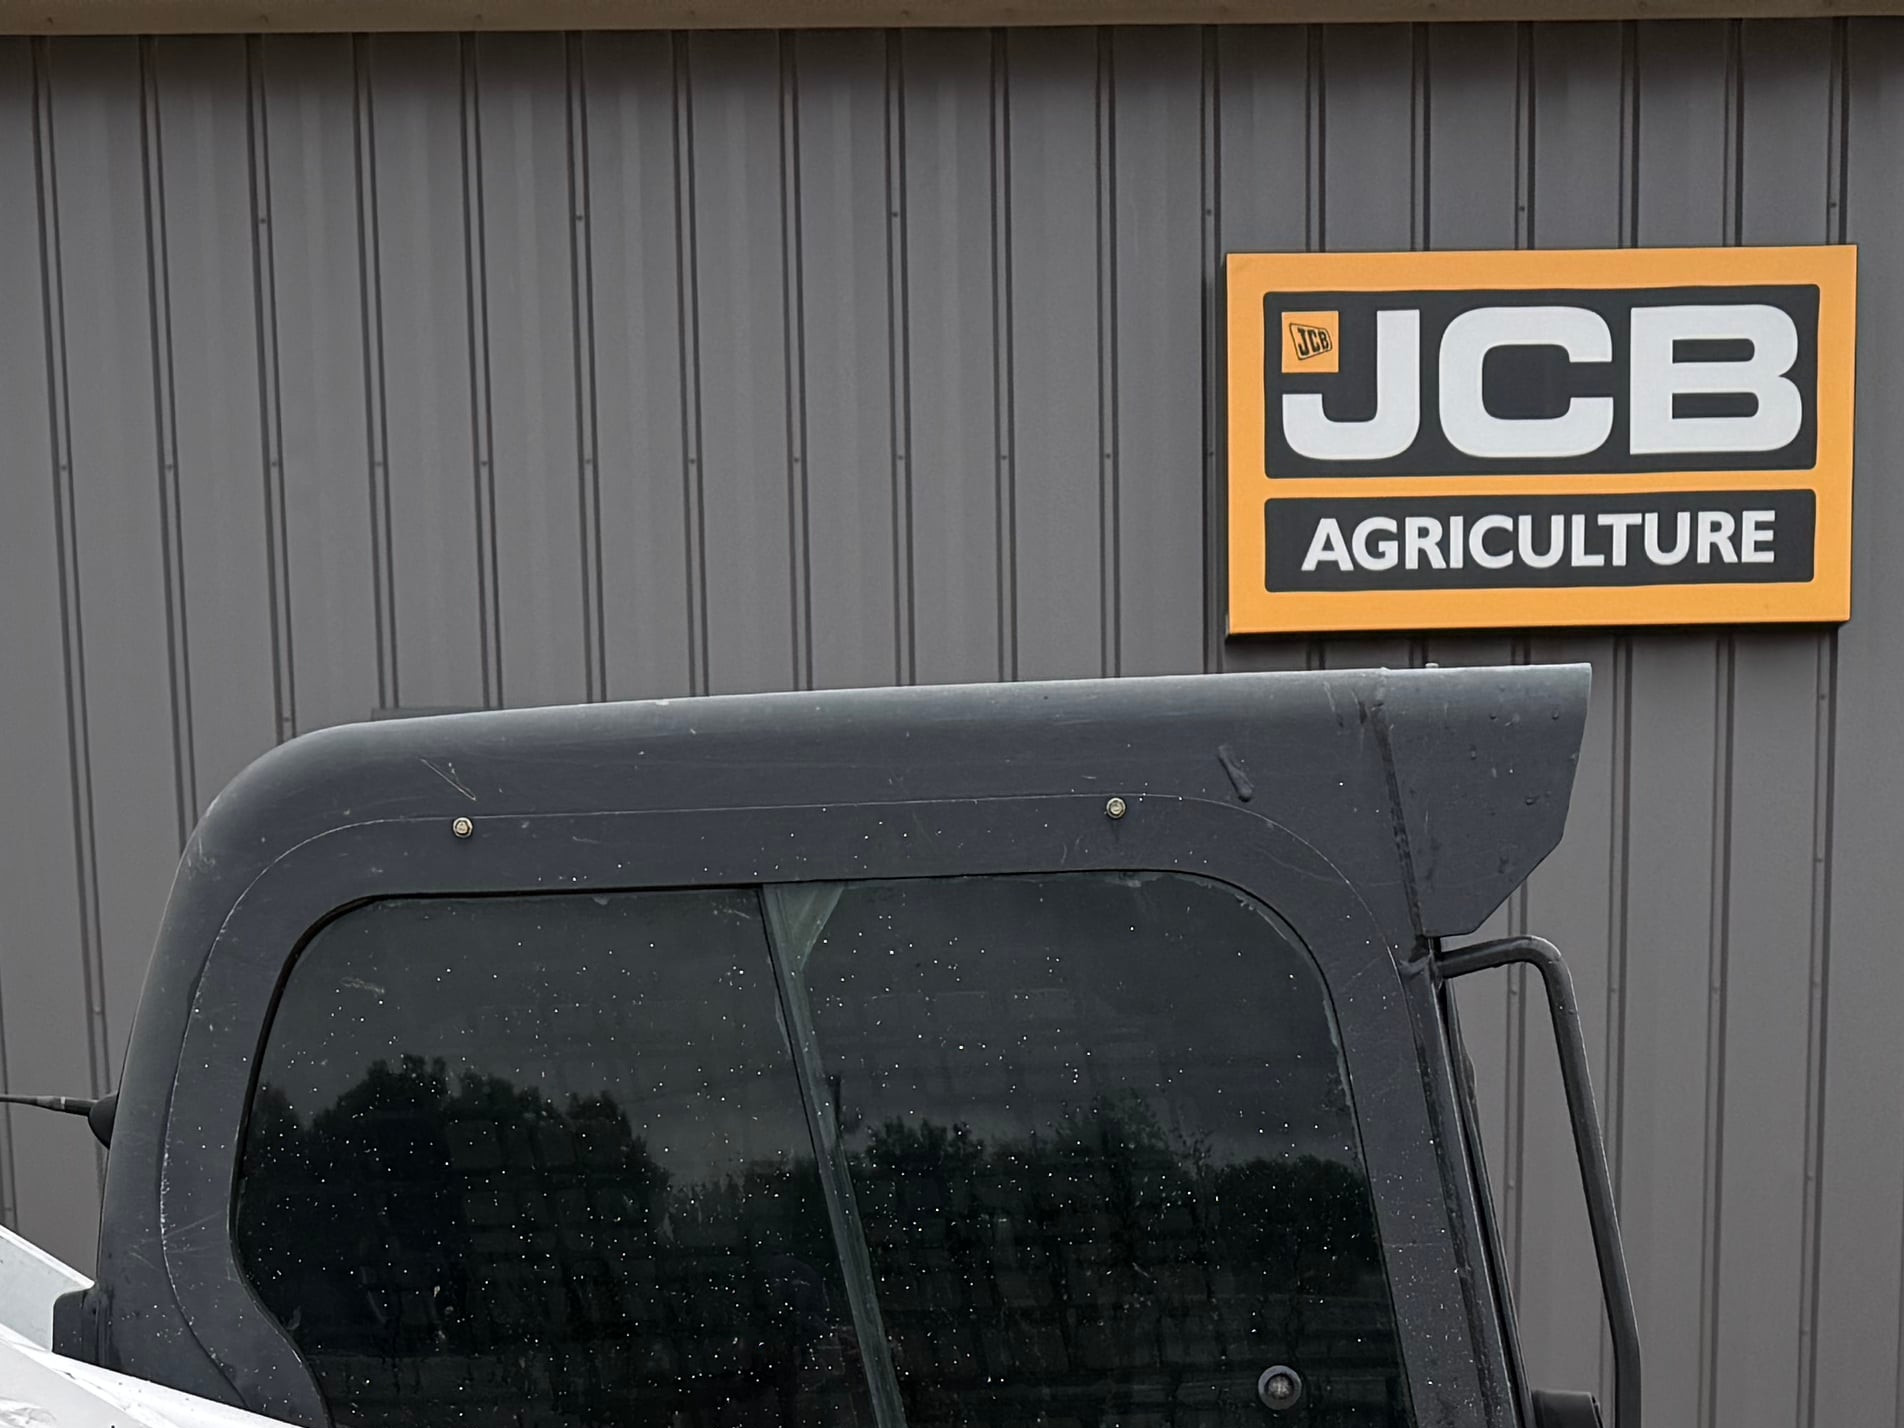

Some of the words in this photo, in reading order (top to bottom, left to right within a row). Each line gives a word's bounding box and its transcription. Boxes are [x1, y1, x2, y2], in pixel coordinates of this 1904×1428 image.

[1297, 326, 1330, 356] JCB
[1282, 303, 1803, 460] JCB
[1301, 510, 1776, 571] AGRICULTURE
